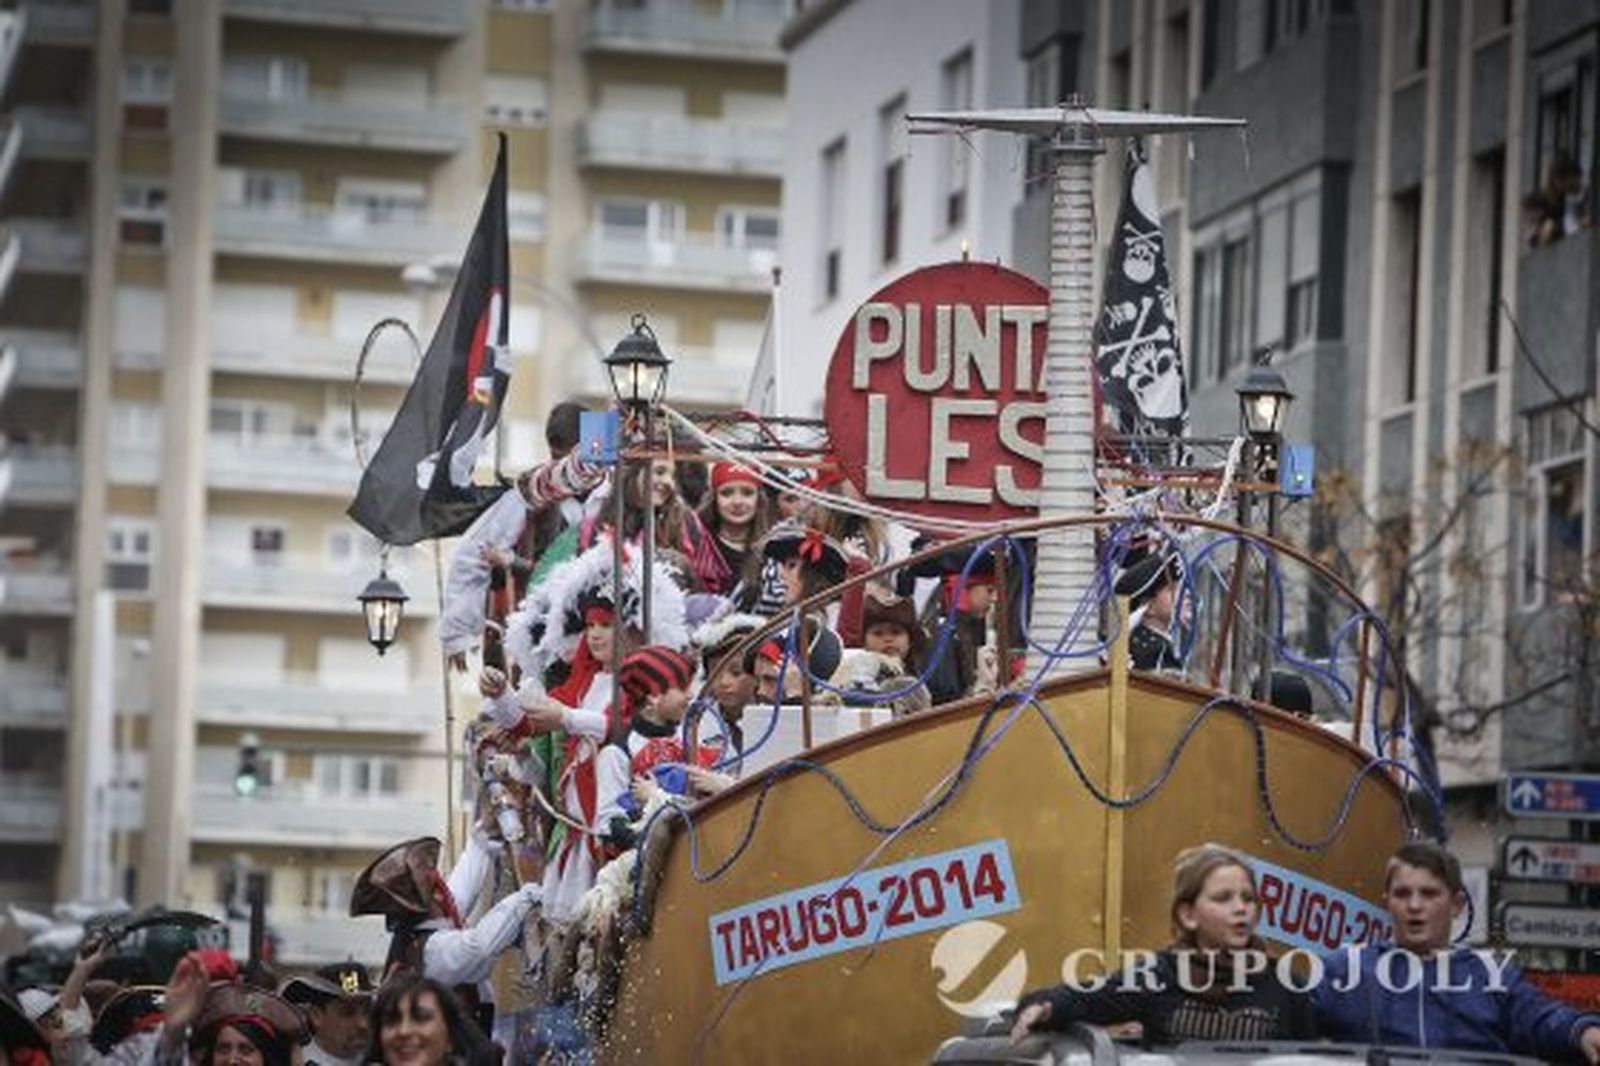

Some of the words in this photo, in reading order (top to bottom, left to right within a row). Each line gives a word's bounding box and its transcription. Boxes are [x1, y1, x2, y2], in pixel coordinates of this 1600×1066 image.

[853, 302, 1049, 392] PUNT
[866, 394, 1048, 508] LES
[716, 853, 1006, 971] TARUGO-2014
